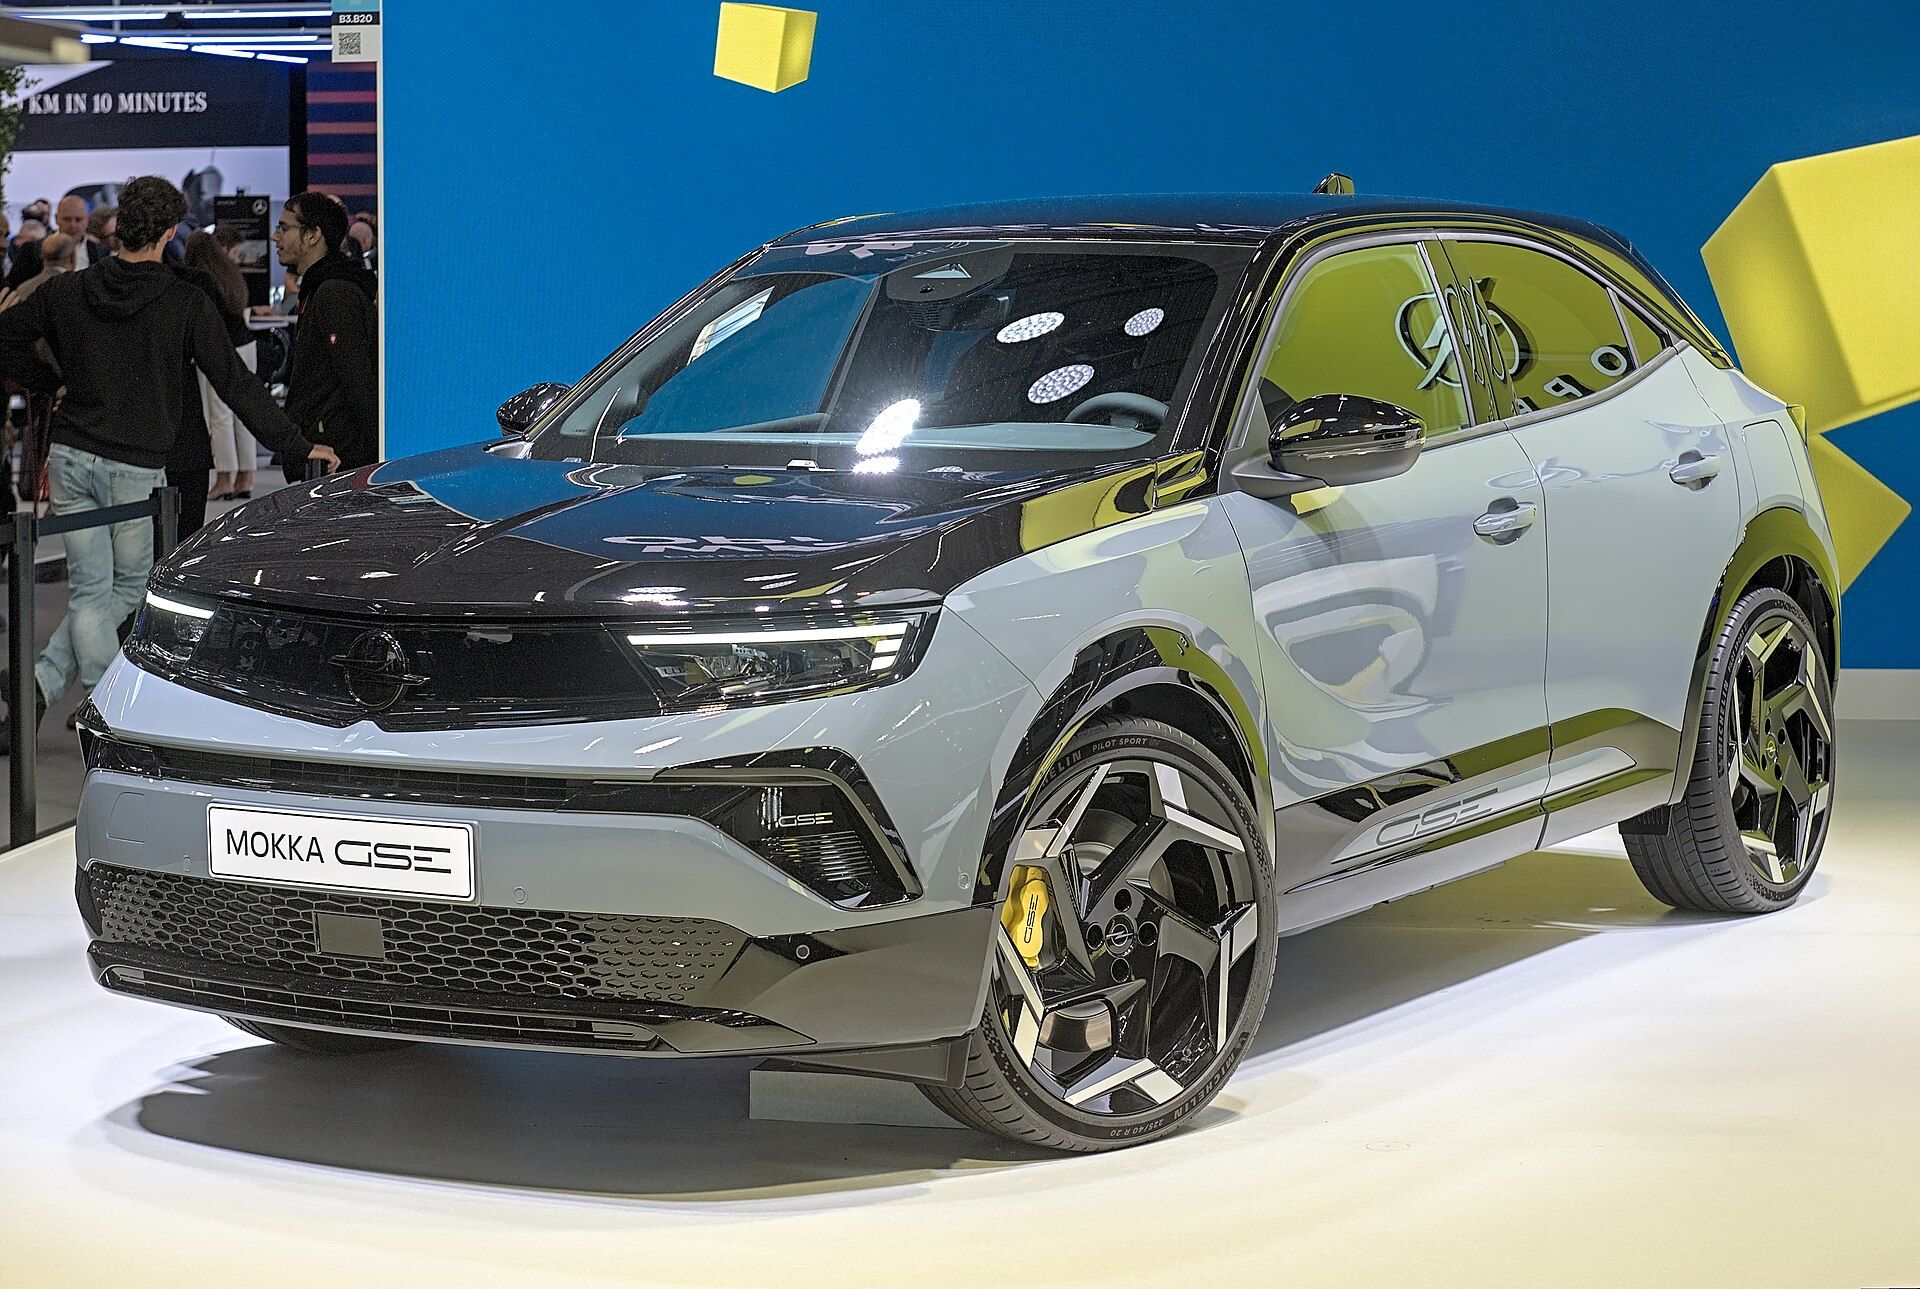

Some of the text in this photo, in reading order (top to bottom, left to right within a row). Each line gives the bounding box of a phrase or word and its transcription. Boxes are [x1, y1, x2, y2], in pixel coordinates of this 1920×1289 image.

[28, 93, 60, 114] KM
[65, 93, 87, 114] IN
[92, 92, 113, 113] 10
[117, 91, 208, 113] MINUTES
[1092, 739, 1117, 752] PILOT
[1119, 738, 1148, 746] SPORT
[779, 812, 833, 827] GSE
[1376, 787, 1498, 846] GSE
[226, 828, 452, 874] MOKKA GSE
[1024, 894, 1039, 943] GSE
[1174, 1052, 1235, 1120] MICHELIN
[1133, 1118, 1164, 1135] 225/40
